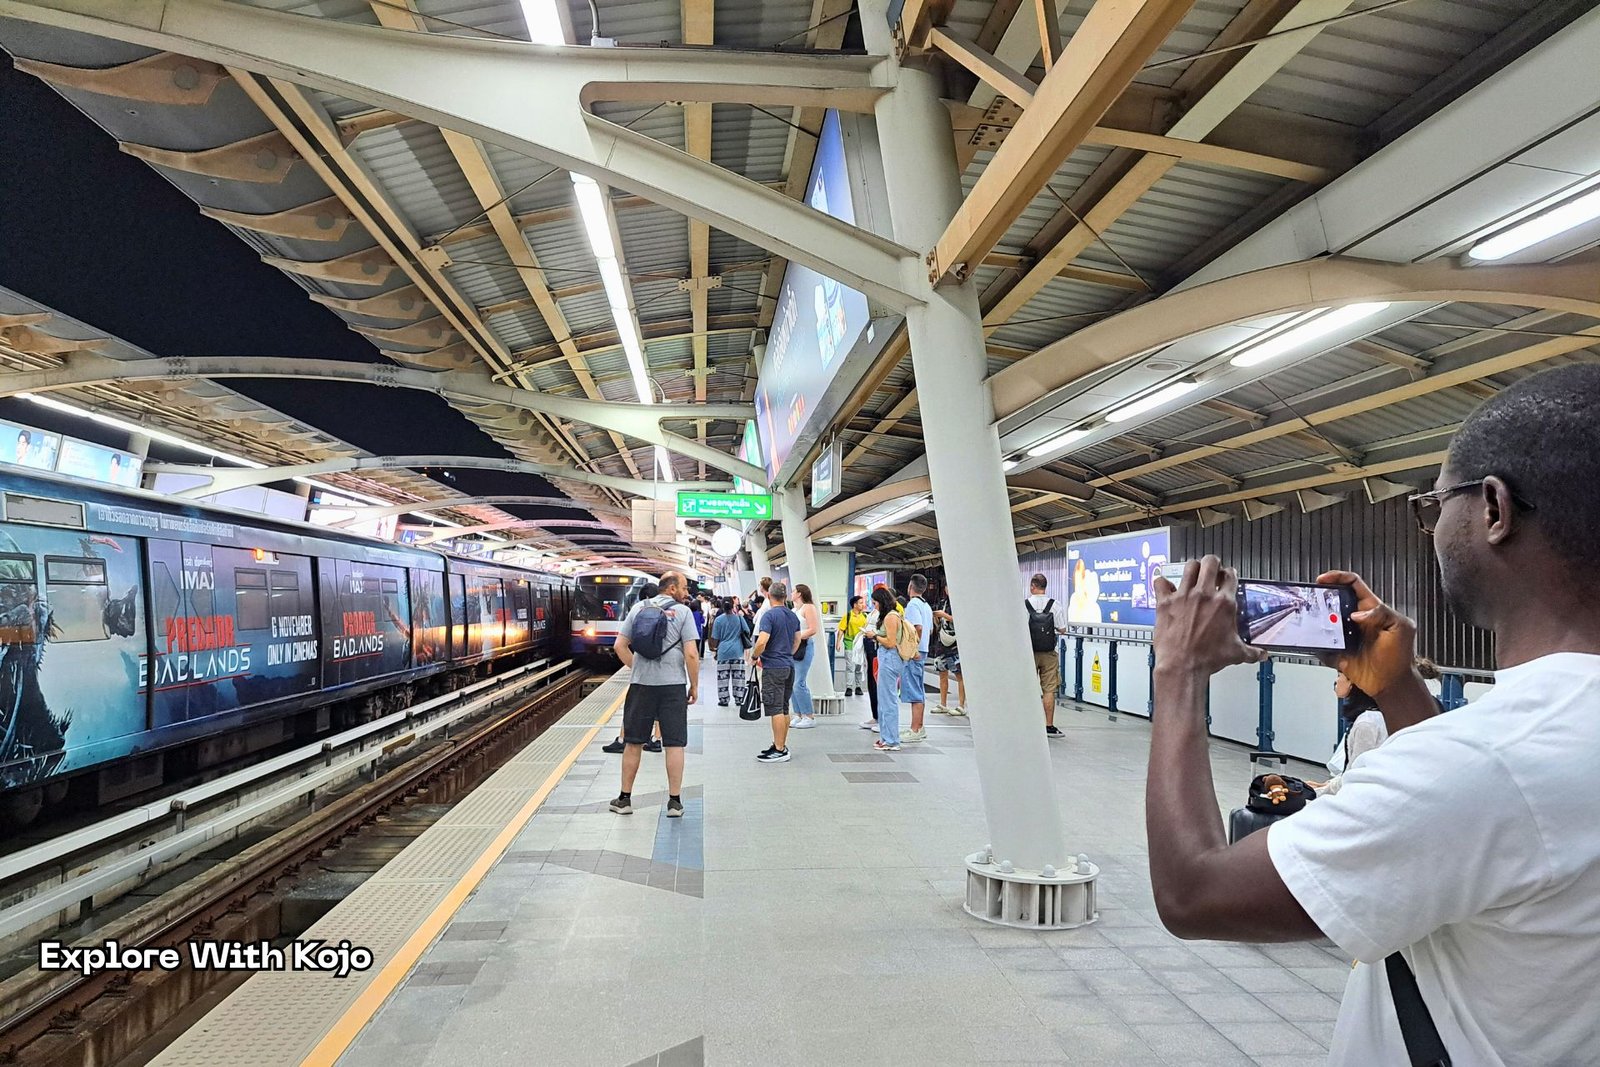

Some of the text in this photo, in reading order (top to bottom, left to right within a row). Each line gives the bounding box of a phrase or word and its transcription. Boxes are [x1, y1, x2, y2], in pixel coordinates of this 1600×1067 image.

[165, 615, 236, 654] PREDAOR
[271, 615, 313, 638] 6 NOVEMBER
[343, 611, 376, 637] PRDATOR
[267, 640, 318, 666] ONLY IN CINEMAS
[333, 635, 384, 658] BADANDS
